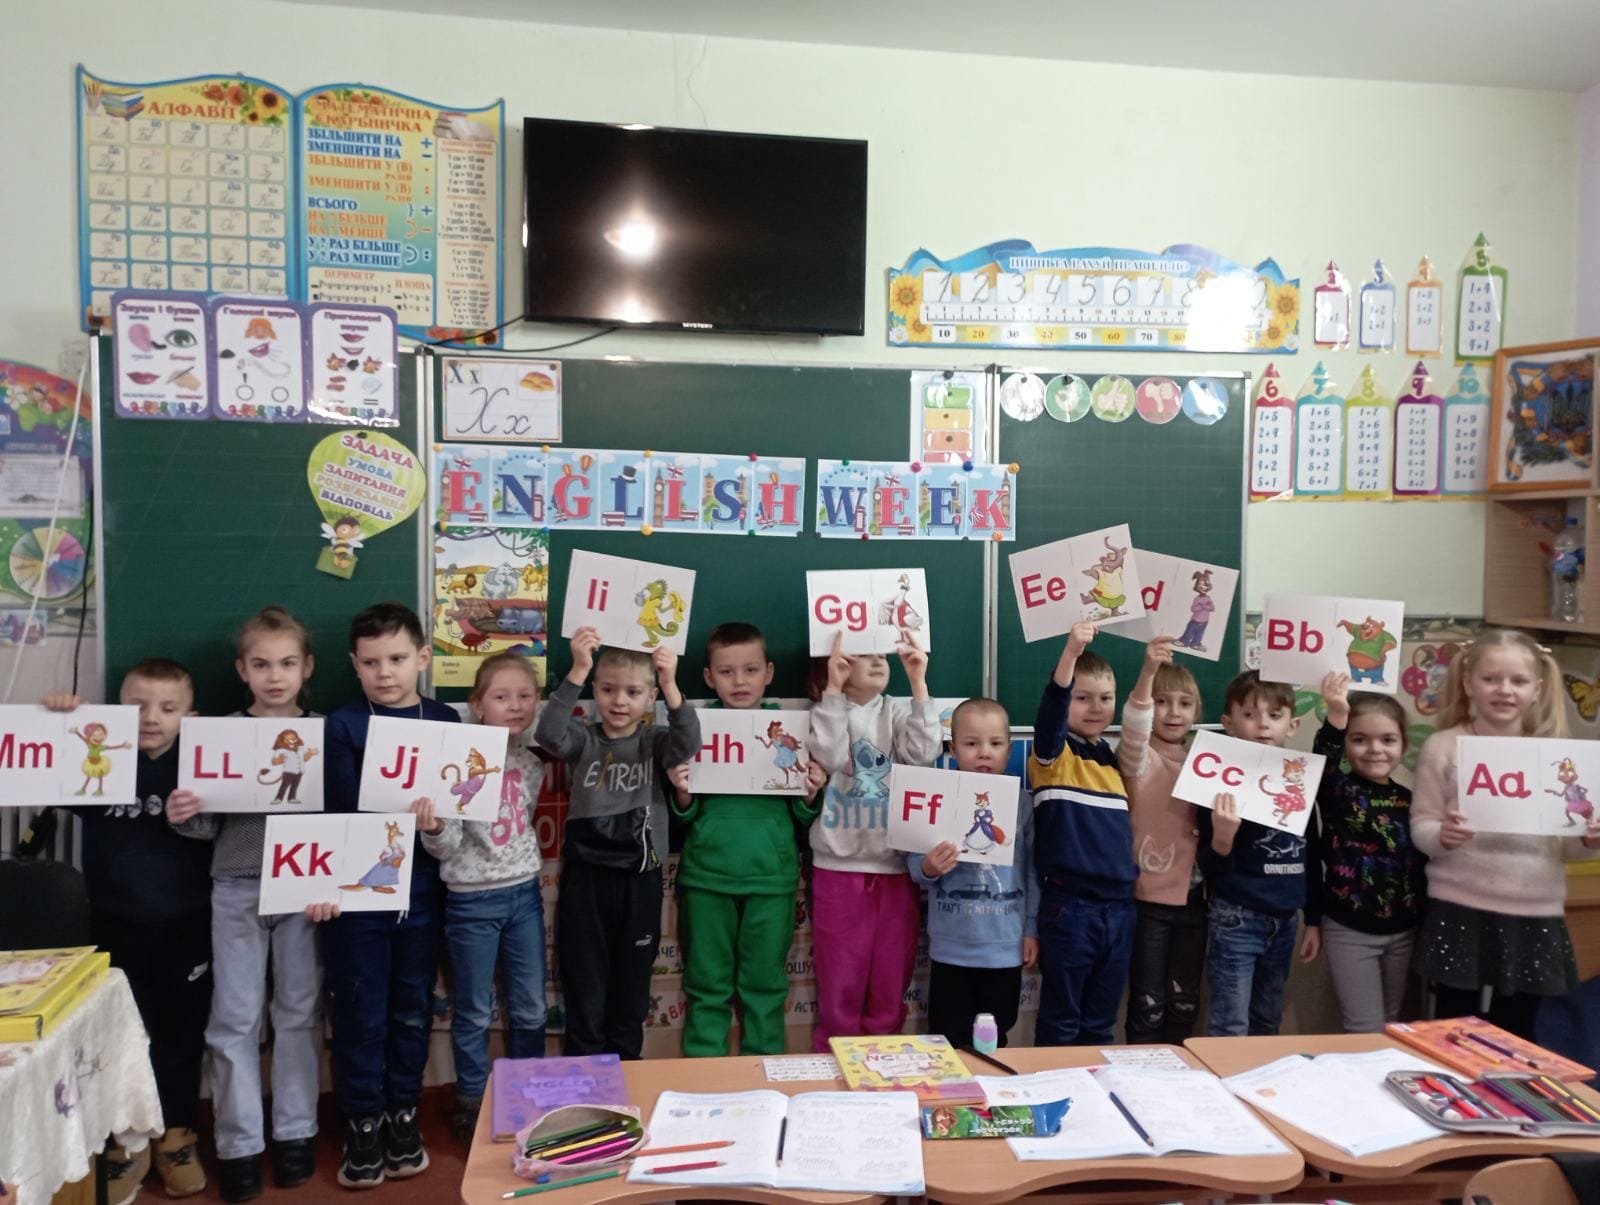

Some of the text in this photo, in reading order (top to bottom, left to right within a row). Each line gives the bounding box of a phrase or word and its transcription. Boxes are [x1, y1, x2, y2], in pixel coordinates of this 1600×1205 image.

[148, 102, 236, 119] АЛФАВІТ
[308, 128, 402, 146] ЗБІЛЬШИТИ НА
[308, 141, 401, 159] ЗМЕНШИТИ НА
[308, 155, 381, 169] ЗБІЛЬШИТИ
[308, 176, 380, 191] ЗМЕНШИТИ
[308, 197, 357, 210] ВСЬОГО
[329, 238, 349, 249] РАЗ
[353, 240, 401, 253] БІЛЬШЕ
[329, 252, 349, 262] РАЗ
[353, 254, 400, 266] МЕНШЕ
[1476, 251, 1490, 268] 5
[939, 271, 953, 303] 1
[973, 273, 991, 302] 2
[1008, 271, 1027, 304] 3
[1044, 274, 1062, 303] 4
[1078, 275, 1096, 304] 5
[1113, 277, 1131, 306] 6
[939, 329, 950, 337] 10
[973, 330, 984, 338] 20
[1075, 332, 1086, 340] 50
[1108, 332, 1120, 340] 60
[1265, 380, 1278, 398] 6
[1361, 381, 1375, 398] 8
[1412, 378, 1425, 396] 9
[1459, 378, 1480, 394] 10
[342, 435, 413, 469] ЗАДАЧА
[348, 457, 393, 480] УМОВА
[325, 464, 406, 497] ЗАПИТАННЯ
[321, 490, 393, 520] ВІДПОВІДЬ
[446, 470, 1010, 532] ENGLISH WEEK
[1021, 574, 1067, 608] Ee
[815, 595, 868, 631] Gg
[1266, 619, 1324, 654] Bb
[694, 733, 744, 763] Hh
[380, 745, 419, 790] Jj
[1192, 752, 1245, 787] Cc
[1466, 763, 1532, 799] Aa
[902, 790, 943, 825] Ff
[271, 842, 334, 878] Kk
